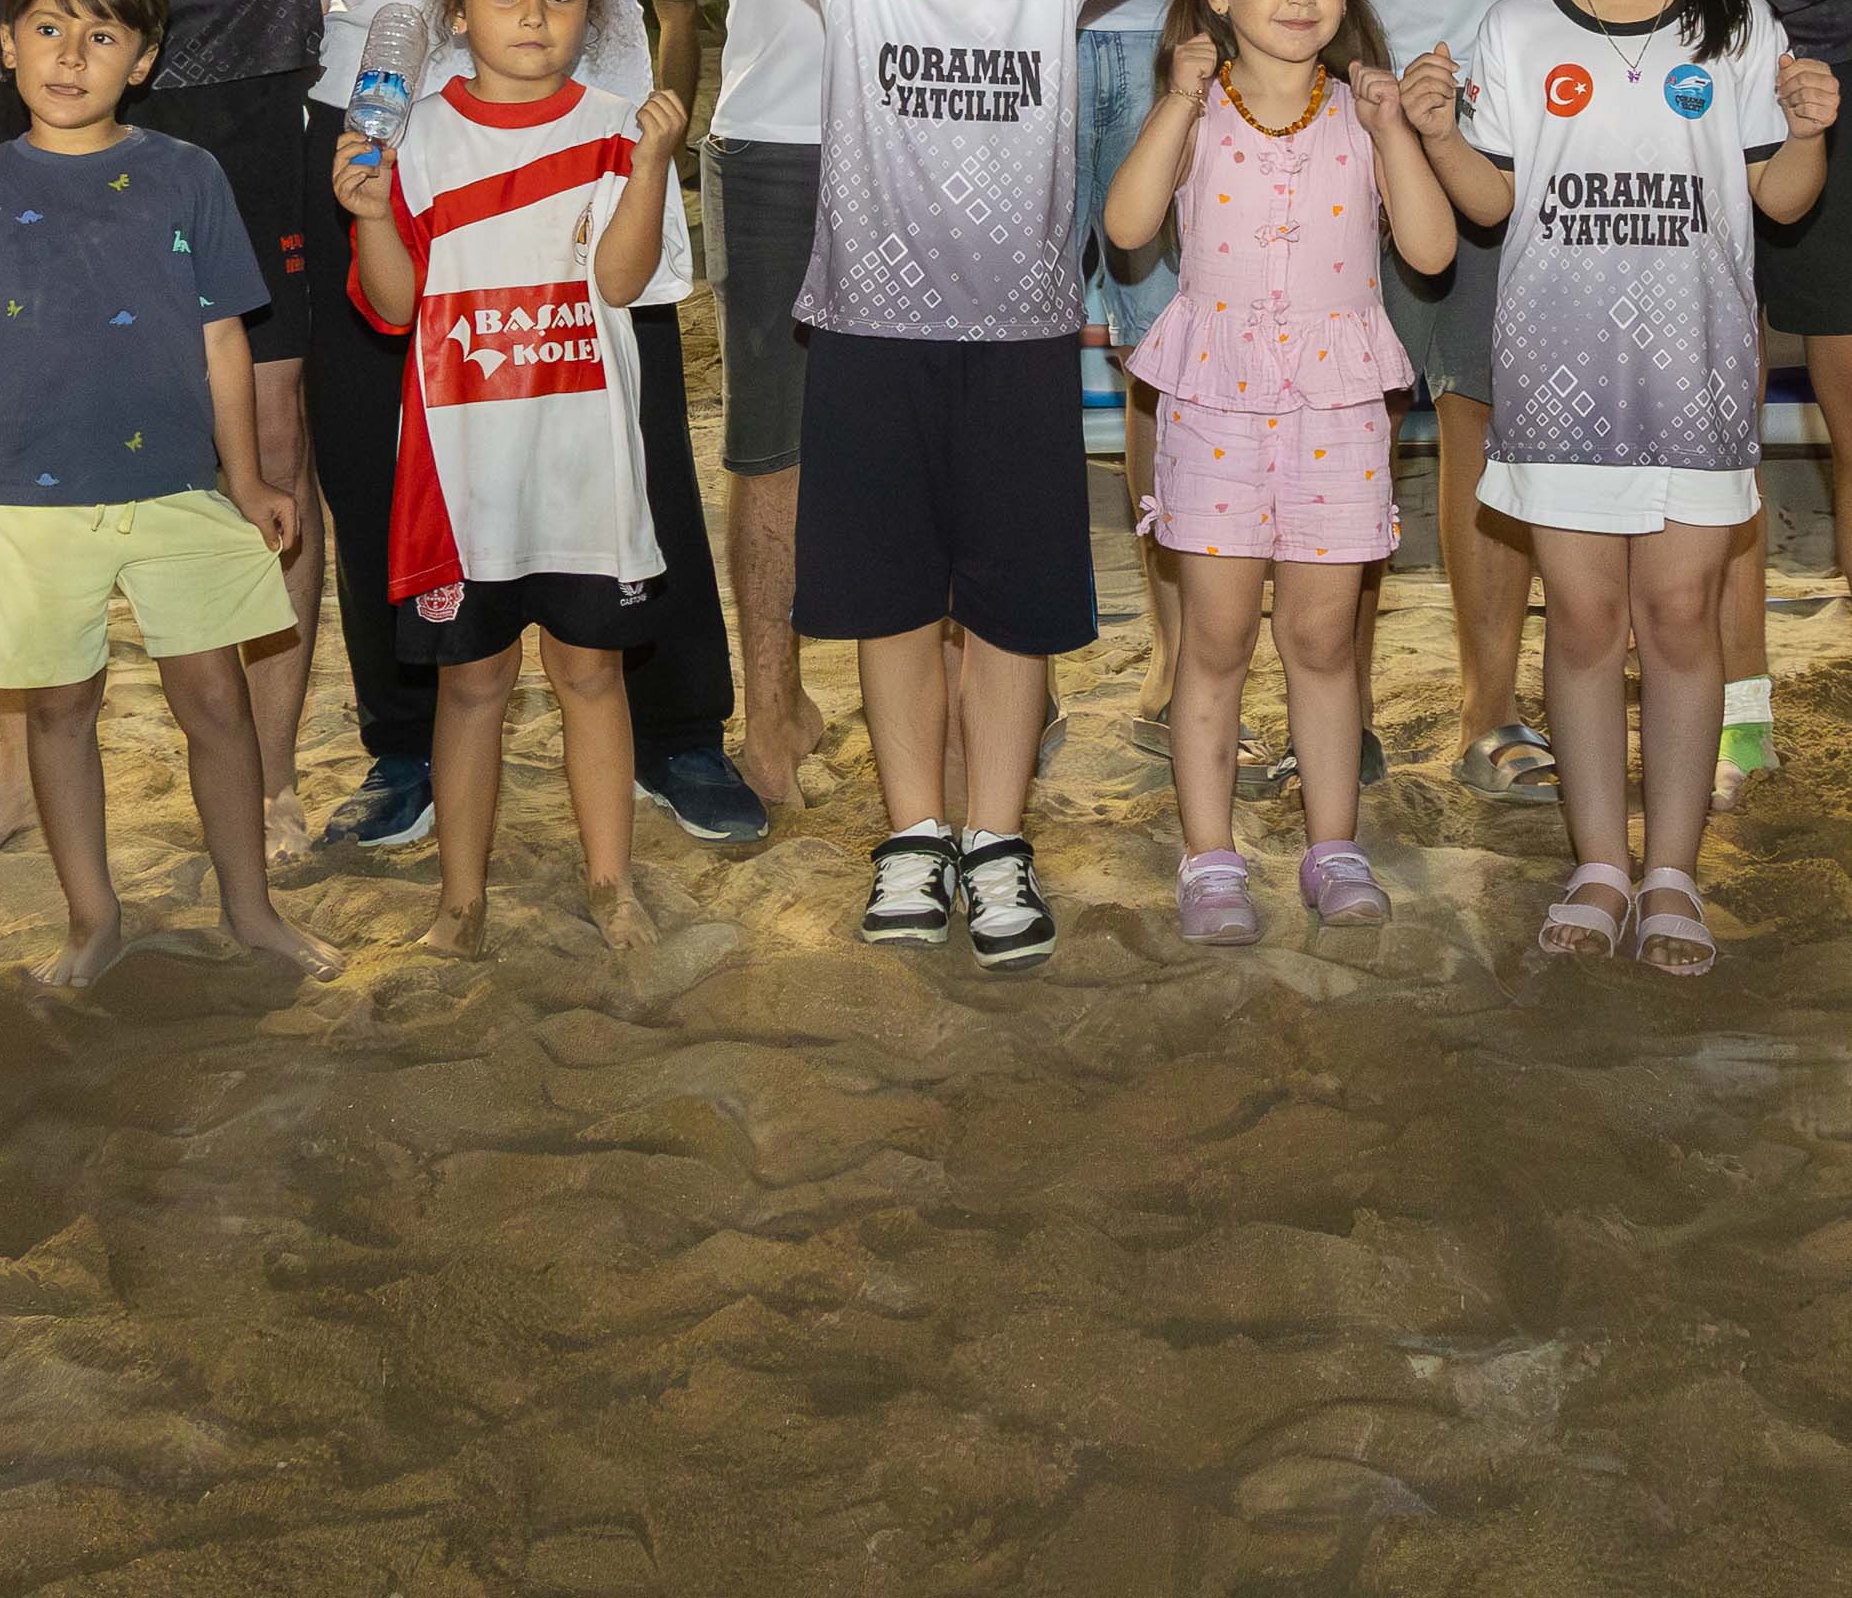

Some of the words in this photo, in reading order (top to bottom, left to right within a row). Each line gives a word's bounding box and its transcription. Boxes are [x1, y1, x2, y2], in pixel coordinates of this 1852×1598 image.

[878, 42, 1043, 108] ÇORAMAN
[897, 86, 1021, 123] YATCILIK
[1539, 172, 1708, 240] ÇORAMAN
[1559, 213, 1690, 248] YATCILIK
[474, 301, 596, 337] BAŞAR
[513, 337, 602, 366] KOLEJ
